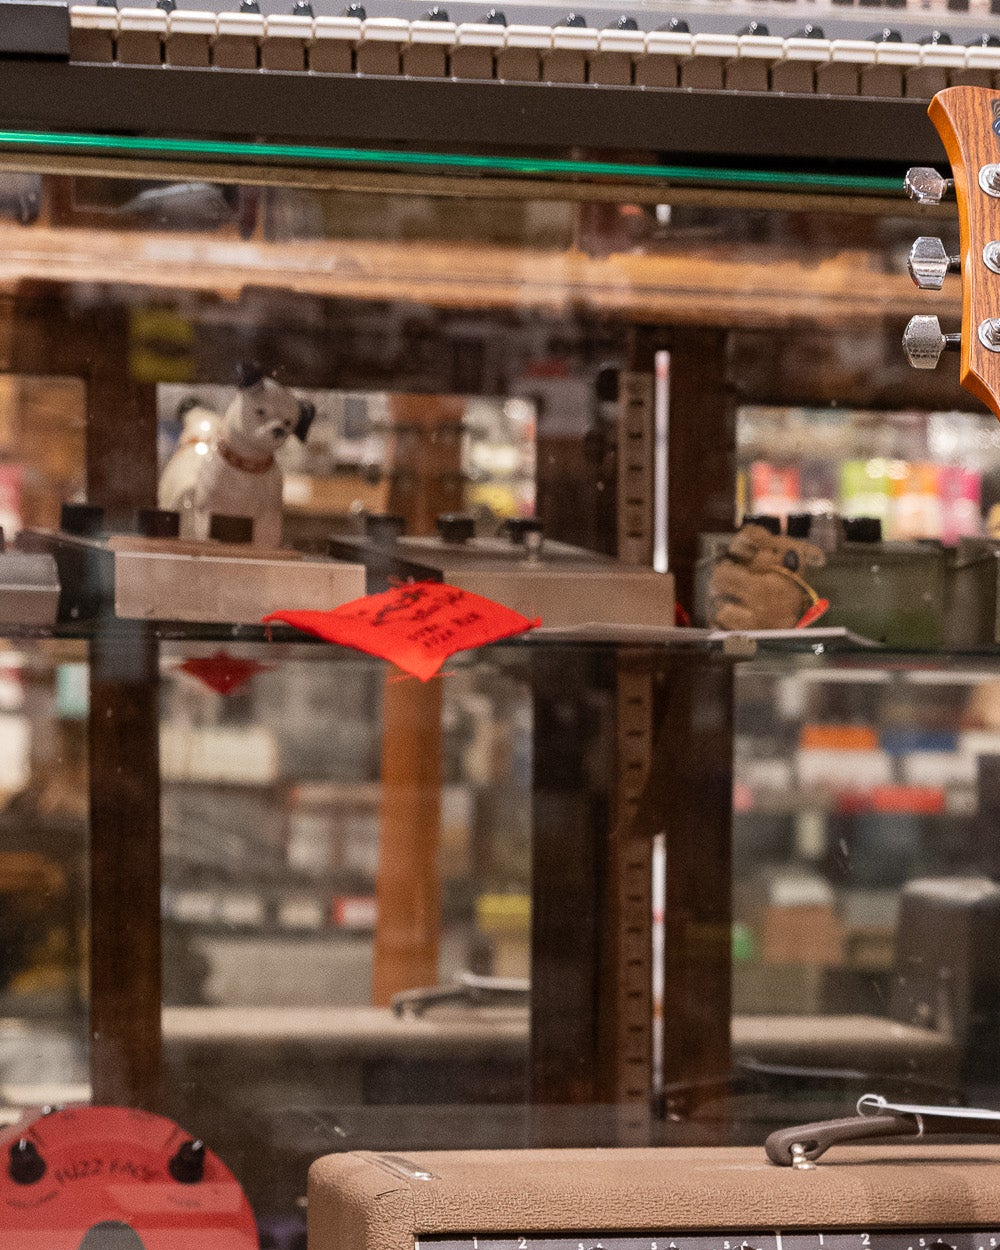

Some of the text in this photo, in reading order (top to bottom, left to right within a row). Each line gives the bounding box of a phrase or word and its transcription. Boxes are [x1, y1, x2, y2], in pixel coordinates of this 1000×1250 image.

[472, 1237, 479, 1250] 1
[517, 1237, 528, 1250] 2
[819, 1233, 824, 1245] 1
[861, 1233, 871, 1245] 2
[919, 1238, 926, 1247] 5
[990, 1238, 997, 1246] 5
[651, 1242, 658, 1250] 5
[724, 1241, 730, 1250] 5
